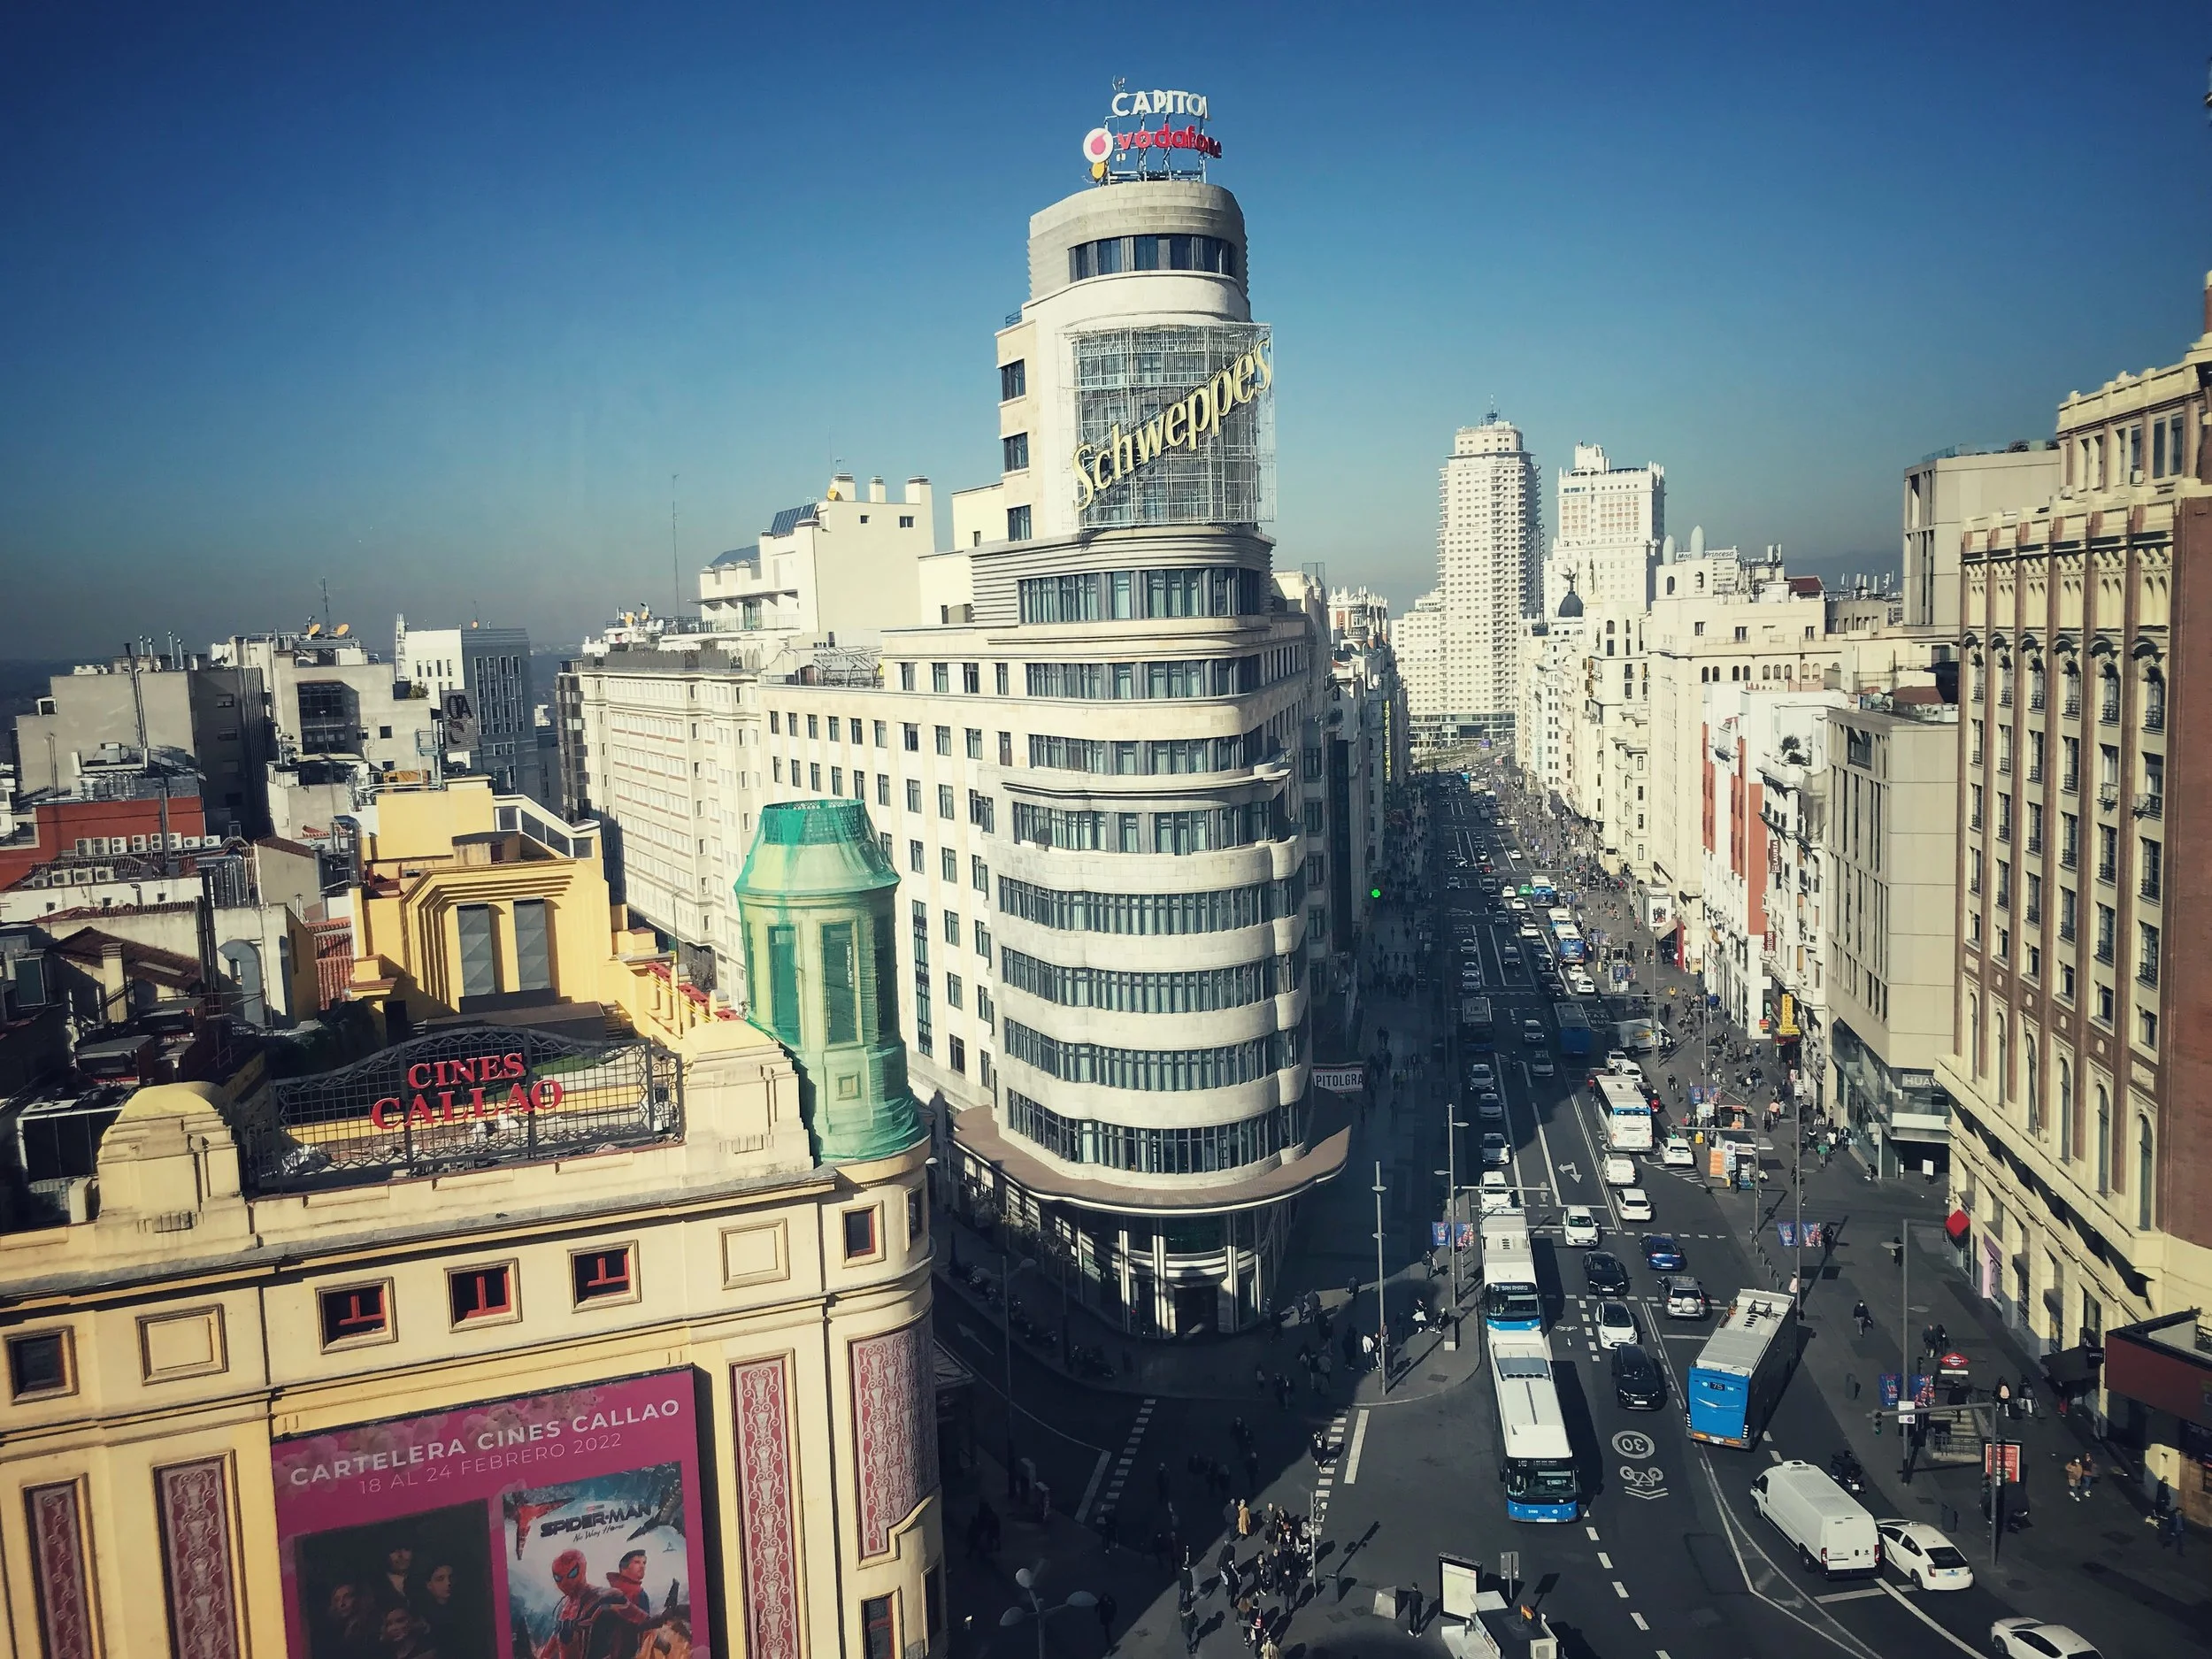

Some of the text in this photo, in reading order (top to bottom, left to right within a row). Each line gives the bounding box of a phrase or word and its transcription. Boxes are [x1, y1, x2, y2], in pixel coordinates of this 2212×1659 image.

[1072, 337, 1272, 511] Schweppes
[408, 1053, 525, 1089] CINES
[372, 1079, 563, 1130] CALLAO
[290, 1399, 680, 1486] CARTELERA CINES CALLAO
[359, 1433, 621, 1494] 18 AL 24 FEBRERO 2022
